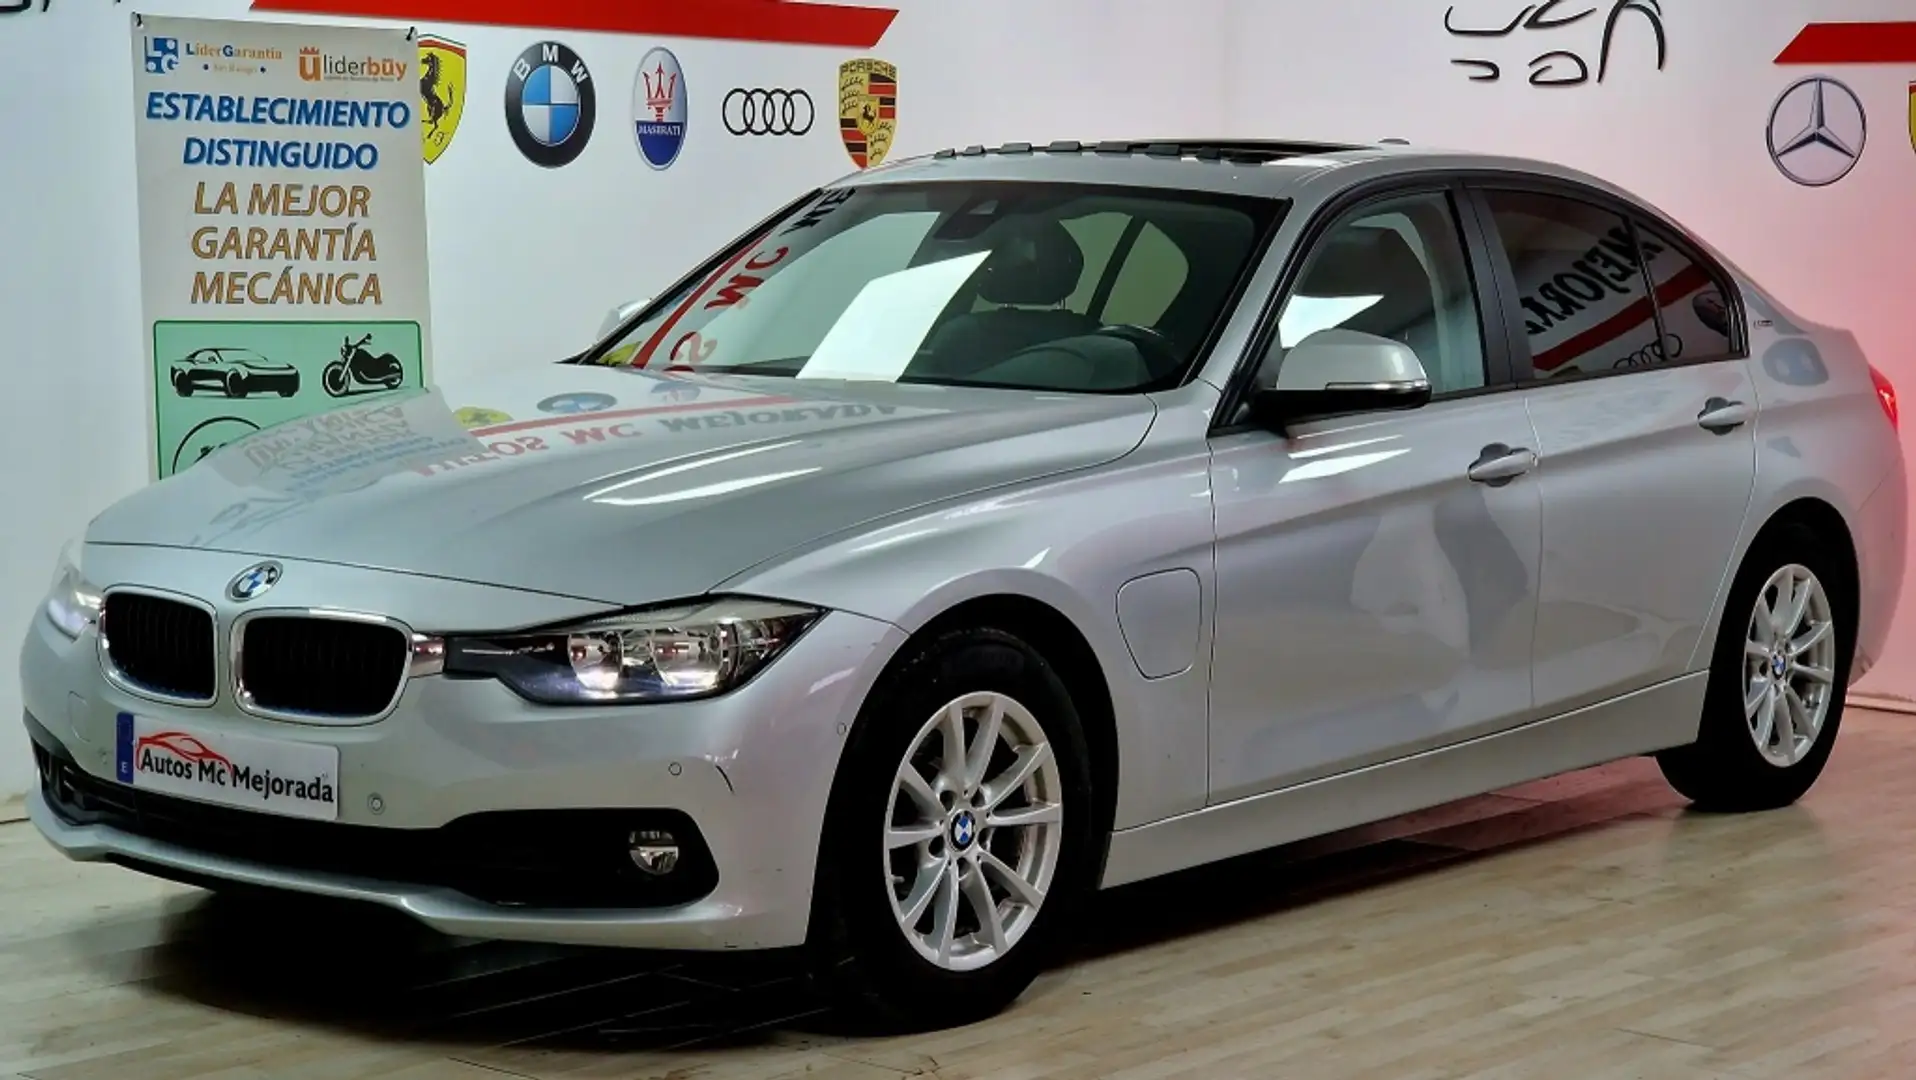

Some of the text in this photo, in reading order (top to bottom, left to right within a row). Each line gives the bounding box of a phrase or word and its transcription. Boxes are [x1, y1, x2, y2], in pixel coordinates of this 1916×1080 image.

[513, 43, 589, 83] BMW
[146, 92, 411, 129] ESTABLECIMIENTO
[637, 125, 681, 137] MASERATI
[183, 137, 379, 170] DISTINGUIDO
[194, 181, 372, 218] LA MEJOR
[191, 222, 377, 262] GARANTÍA
[190, 265, 383, 306] MECÁNICA
[120, 761, 128, 774] E
[141, 748, 334, 803] Autos Mc Mejorada
